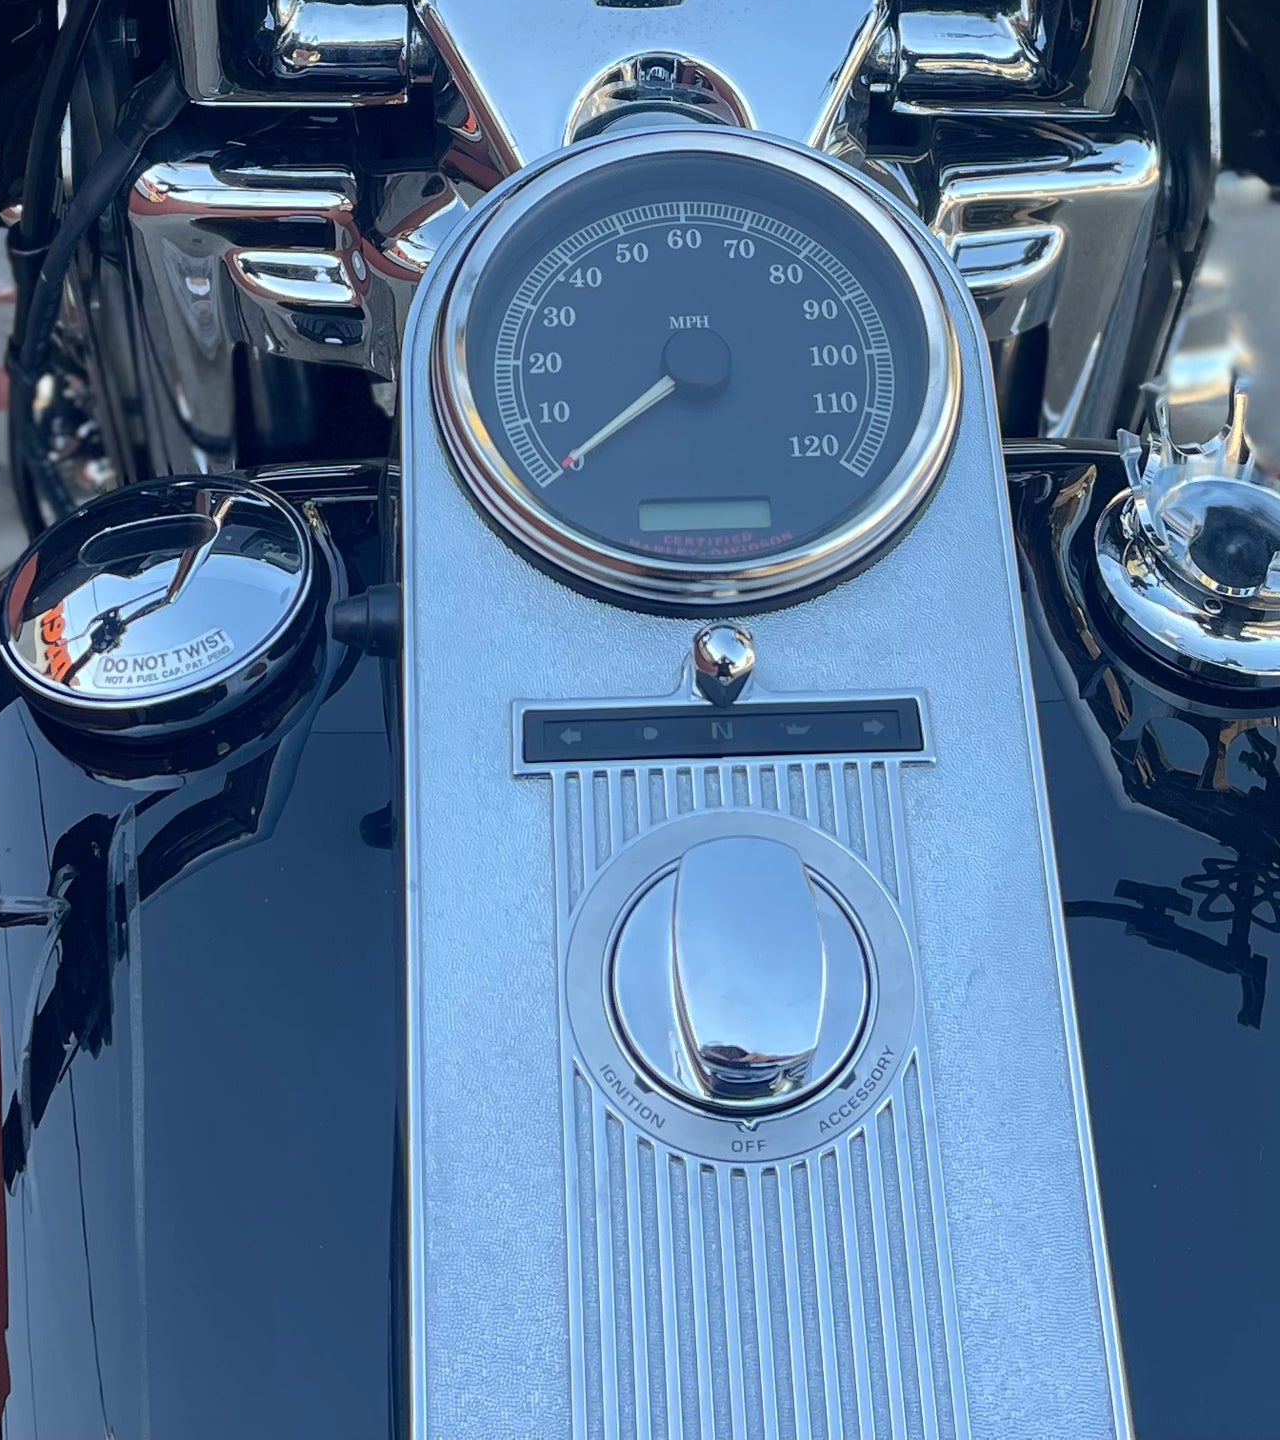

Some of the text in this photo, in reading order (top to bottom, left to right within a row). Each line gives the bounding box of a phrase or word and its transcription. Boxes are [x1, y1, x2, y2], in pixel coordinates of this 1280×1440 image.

[667, 228, 702, 250] 60
[723, 238, 756, 259] 70
[615, 242, 649, 263] 50
[569, 266, 603, 288] 40
[769, 263, 804, 285] 80
[543, 305, 576, 327] 30
[802, 298, 838, 321] 90
[669, 314, 710, 330] MPH
[529, 351, 563, 374] 20
[809, 344, 858, 367] 100
[539, 400, 570, 424] 10
[812, 391, 858, 414] 110
[788, 433, 840, 458] 120
[663, 531, 752, 547] CERTIFIED
[102, 629, 227, 674] DO NOT TWIST
[105, 675, 124, 685] NOT
[126, 675, 133, 684] A
[136, 672, 159, 683] FUEL
[711, 720, 734, 741] N
[599, 1063, 666, 1130] IGNITION
[818, 1046, 895, 1133] ACCESSORY
[731, 1139, 768, 1153] OFF
